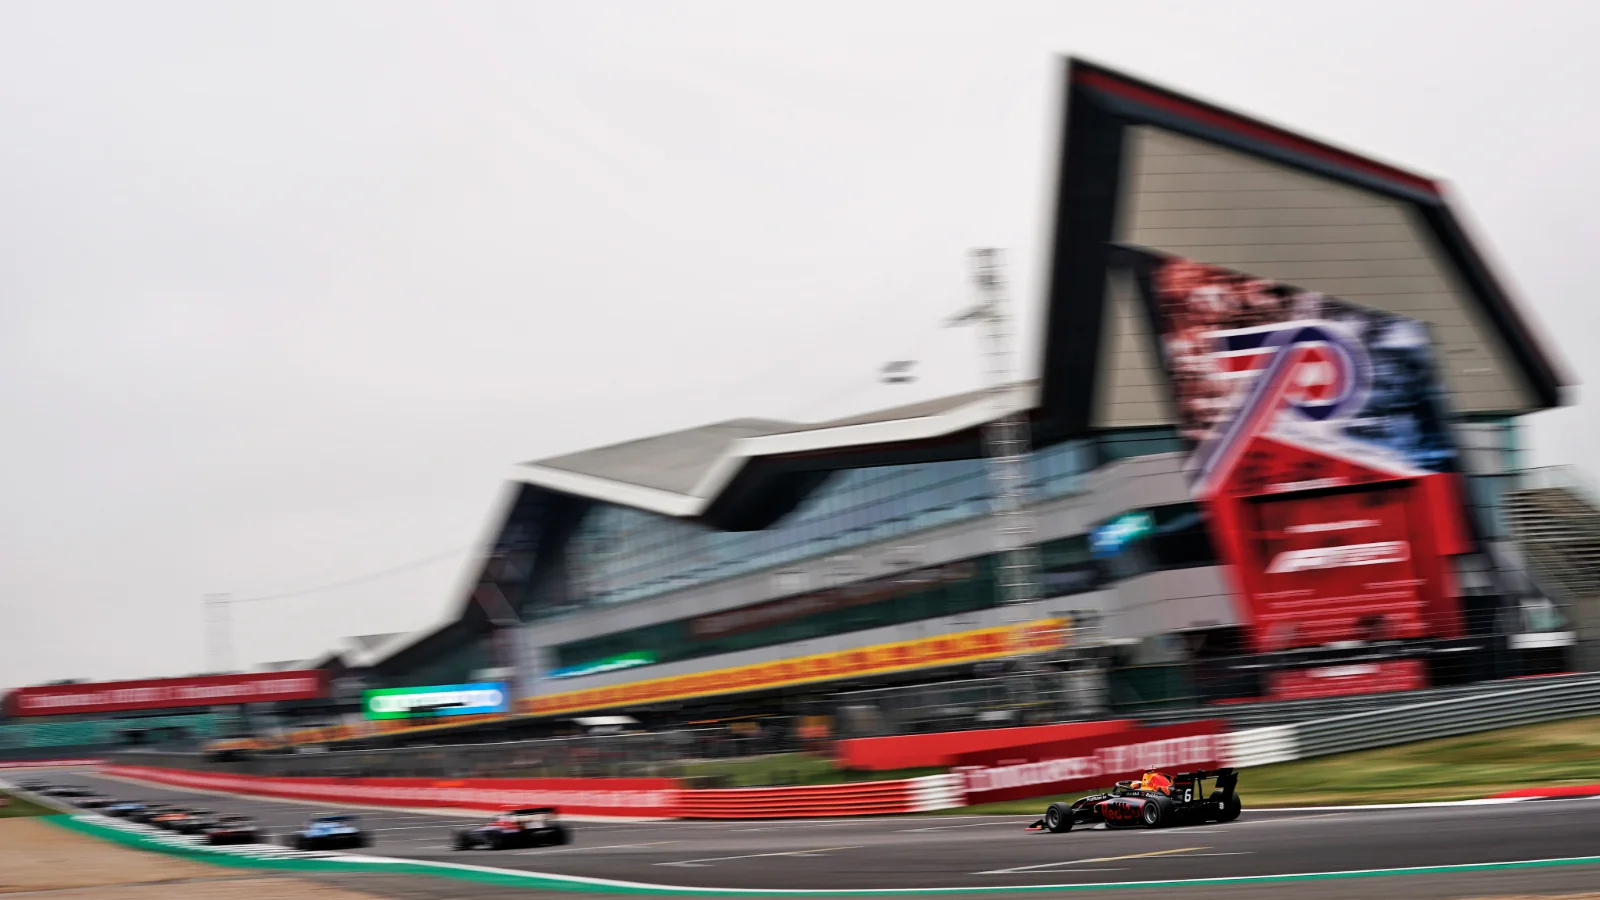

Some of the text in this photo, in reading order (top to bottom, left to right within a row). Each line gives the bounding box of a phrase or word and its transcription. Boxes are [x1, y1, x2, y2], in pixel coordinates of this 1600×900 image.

[1184, 788, 1192, 803] 6
[1101, 803, 1144, 820] Red Bul
